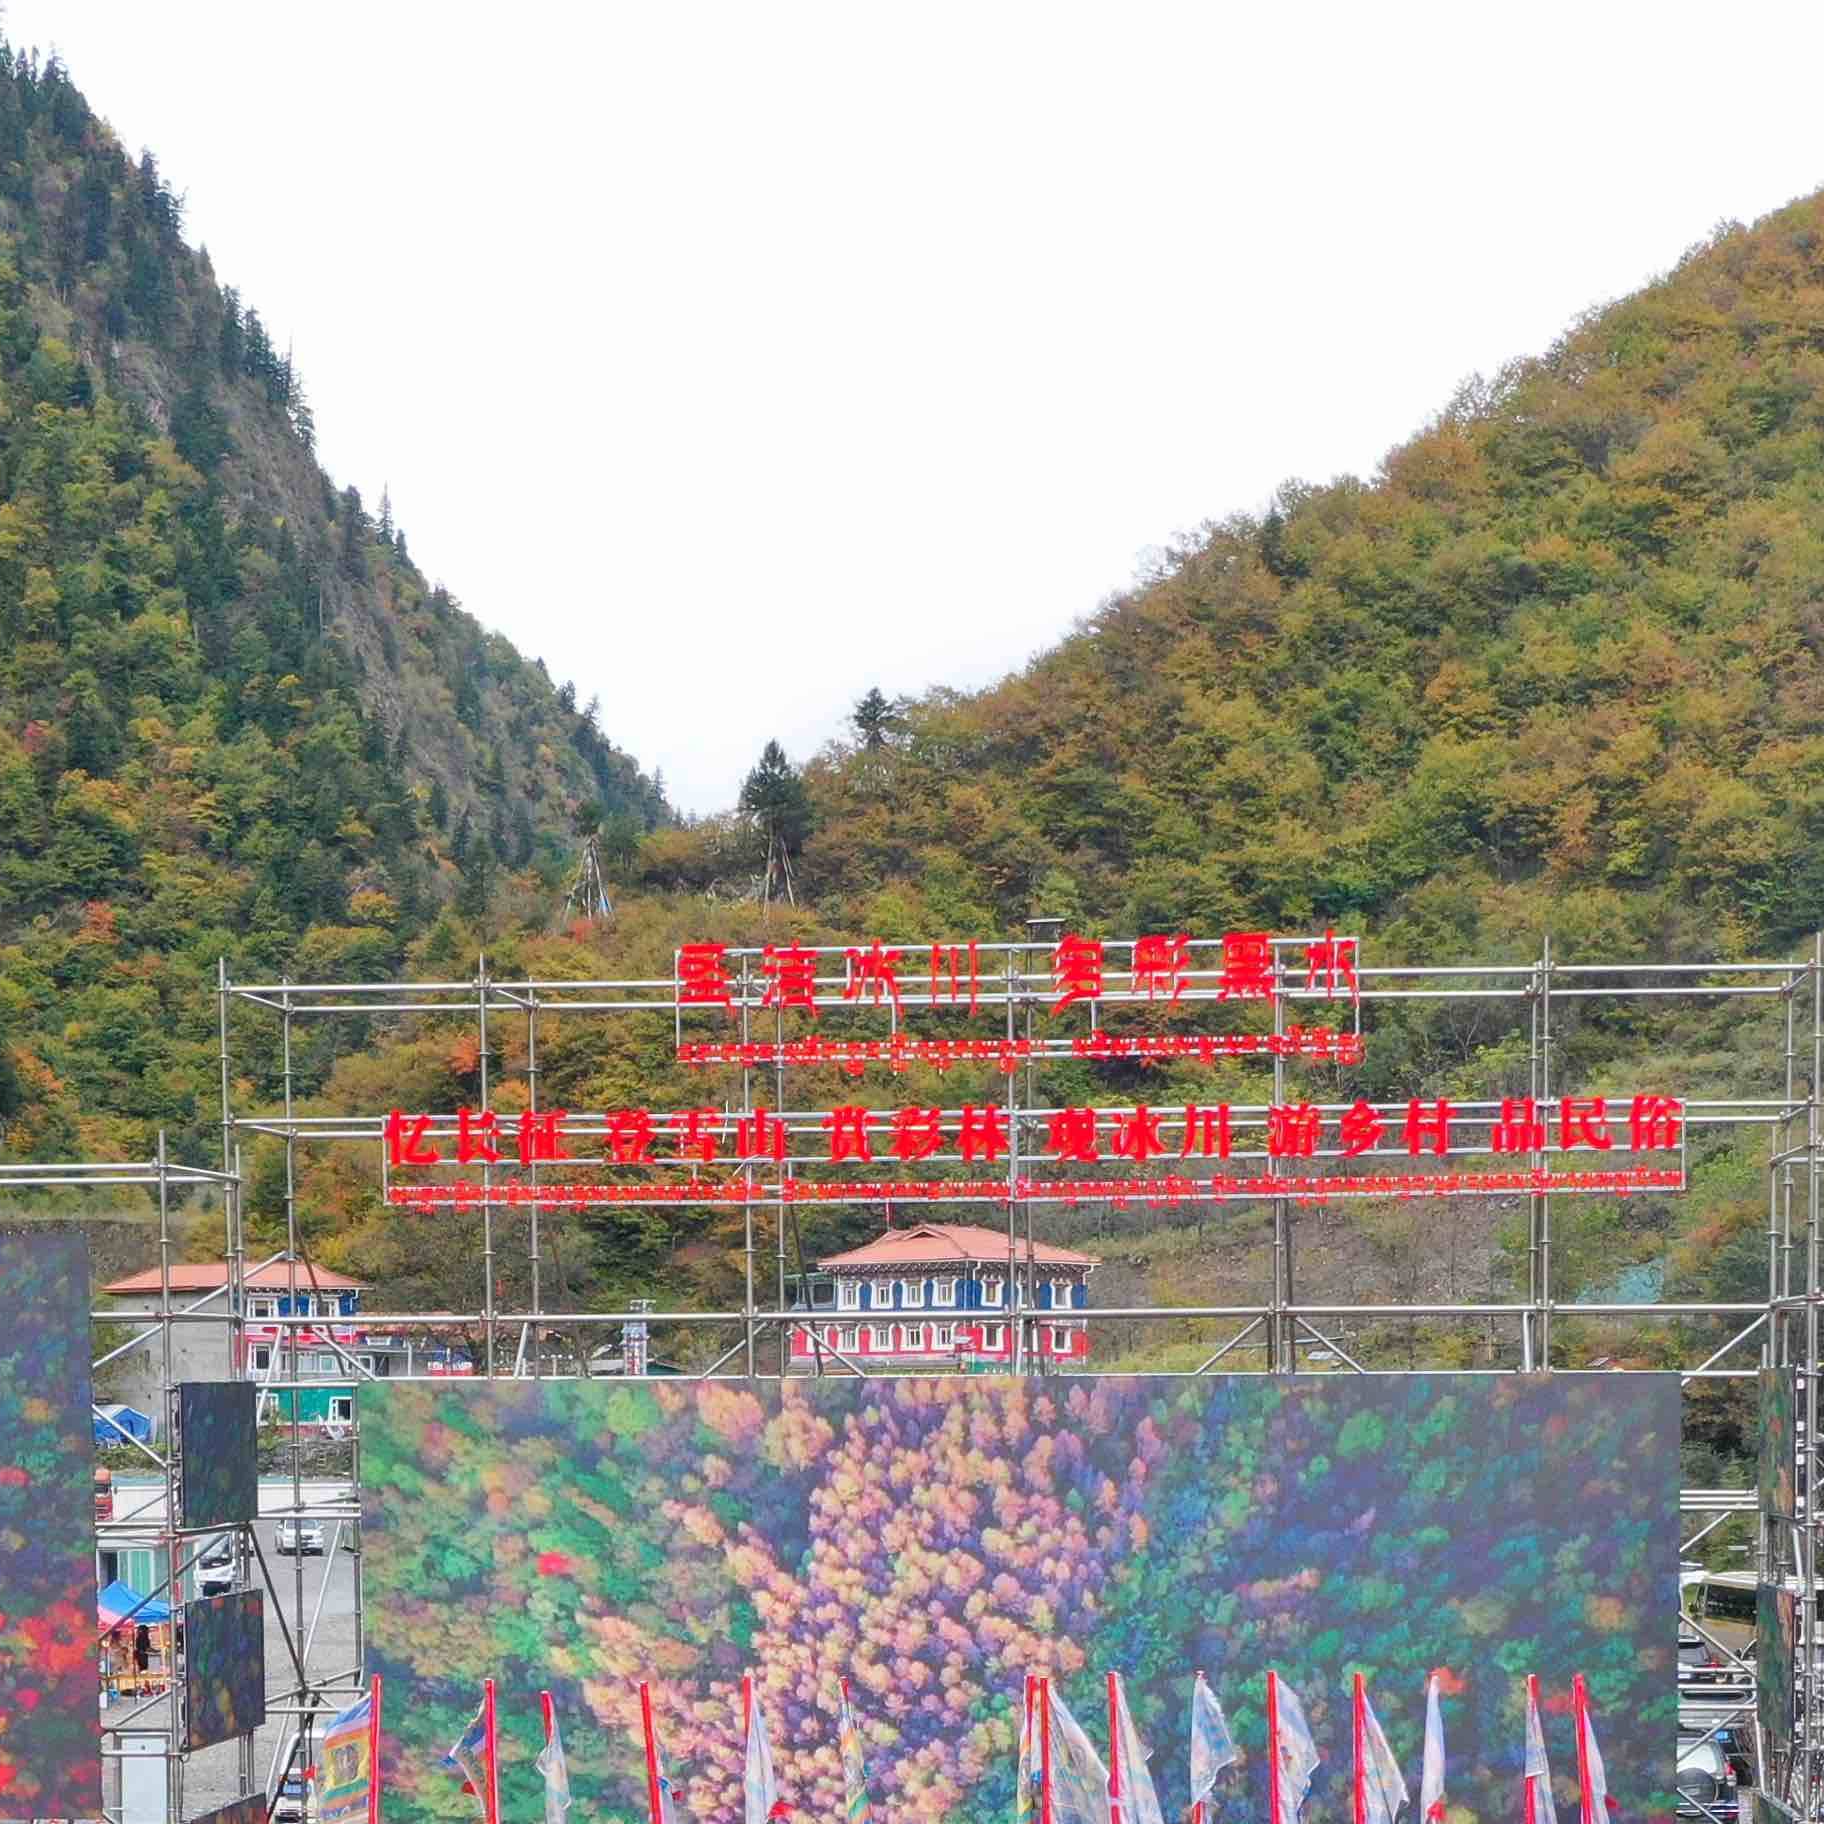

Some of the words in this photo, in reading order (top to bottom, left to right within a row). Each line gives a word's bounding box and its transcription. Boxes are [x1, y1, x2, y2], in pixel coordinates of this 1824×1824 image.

[384, 1107, 567, 1167] 忆长征
[604, 1106, 788, 1165] 登雪山
[822, 1103, 1009, 1164] 赏彩林
[1044, 1103, 1233, 1164] 观冰川
[1267, 1098, 1457, 1158] 游乡村
[1491, 1093, 1682, 1153] 品民俗
